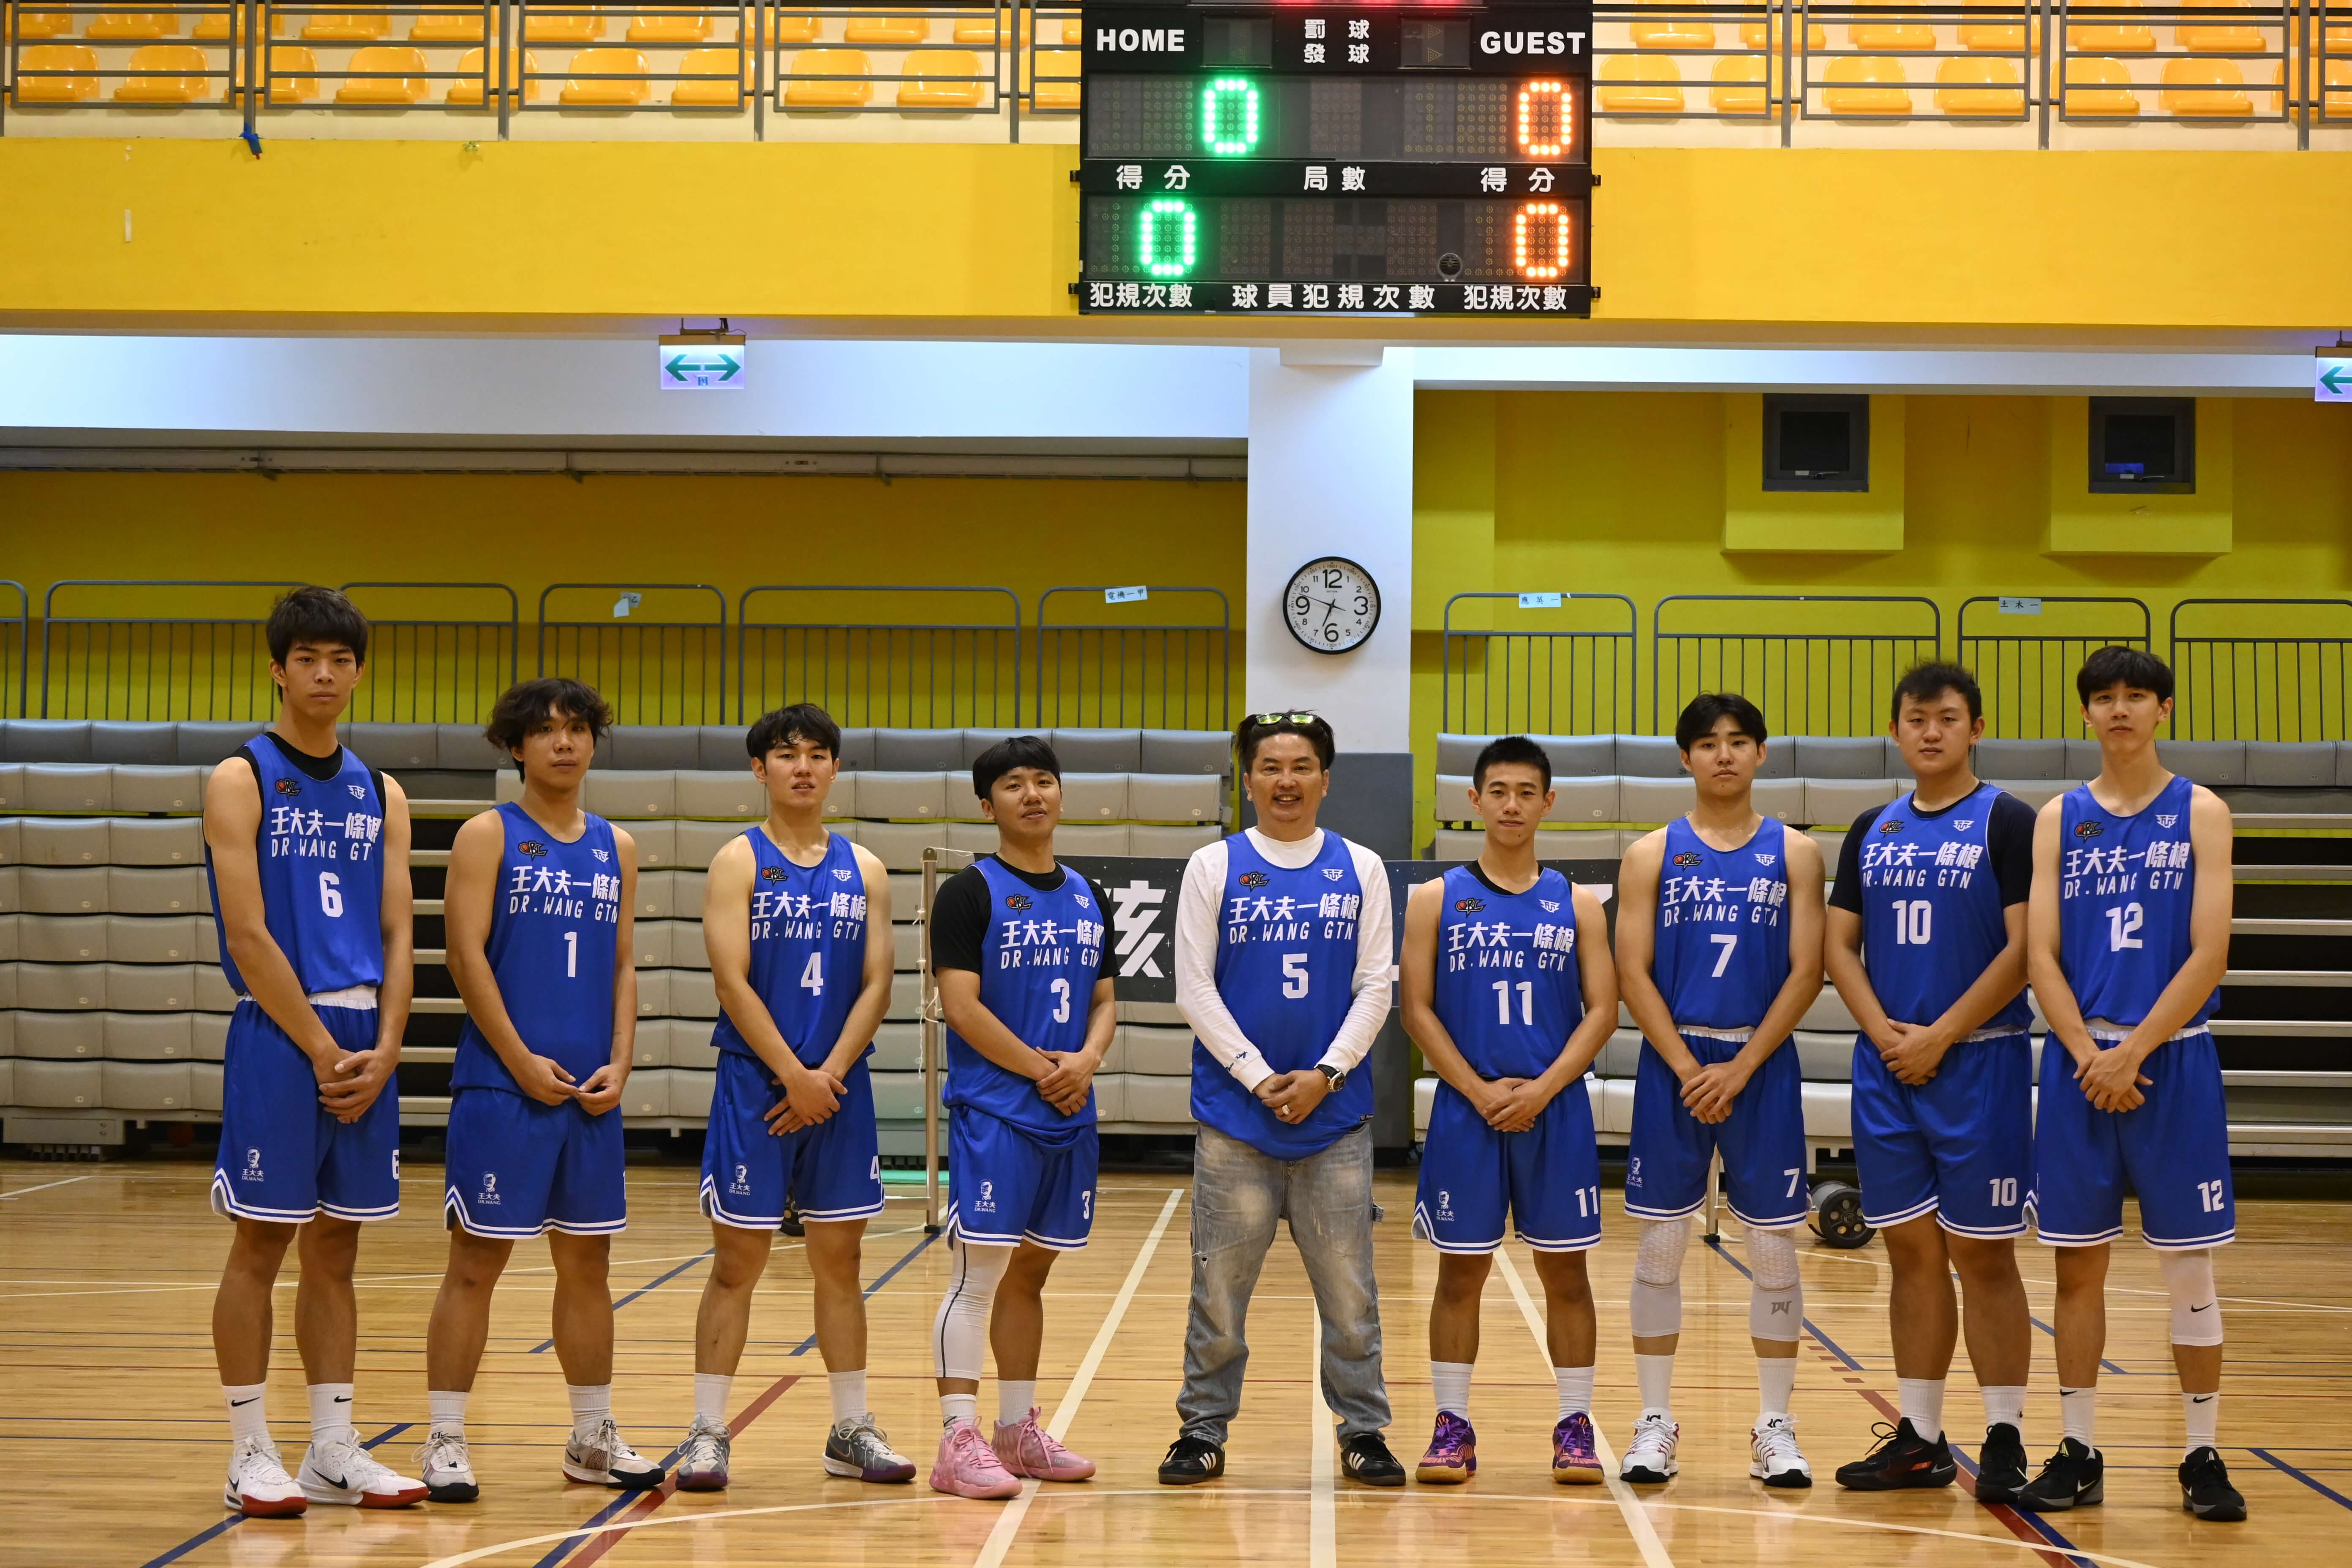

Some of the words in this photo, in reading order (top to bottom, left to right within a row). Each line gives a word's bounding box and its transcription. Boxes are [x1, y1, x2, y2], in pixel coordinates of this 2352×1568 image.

[1097, 29, 1185, 52] HOME
[1304, 19, 1369, 40] 罰球
[1480, 31, 1585, 55] GUEST
[1303, 44, 1369, 64] 發球
[1202, 78, 1259, 154] 0
[1519, 81, 1572, 156] 0
[1116, 166, 1190, 191] 得分
[1303, 166, 1366, 191] 局數
[1481, 168, 1555, 193] 得分
[1141, 201, 1196, 275] 0
[1516, 204, 1569, 278] 0
[1090, 284, 1192, 309] 犯規次數
[1233, 284, 1436, 310] 球員犯規次數
[1464, 285, 1567, 311] 犯規次數
[1322, 569, 1342, 588] 12
[1296, 596, 1310, 615] 9
[1354, 596, 1368, 615] 3
[2001, 600, 2038, 609] 土木一
[1324, 623, 1339, 642] 6
[350, 842, 373, 861] GT
[1862, 841, 1983, 870] 王大夫一條根
[2064, 841, 2190, 878] 王大夫一條根
[319, 871, 343, 917] 6
[752, 891, 866, 921] 王大夫一條根
[1663, 876, 1787, 908] 王大夫一條根
[1228, 893, 1360, 924] 王大夫一條根
[1892, 900, 1932, 945] 10
[1448, 922, 1574, 953] 王大夫一條根
[2106, 902, 2143, 952] 12
[564, 931, 577, 977] 1
[1710, 934, 1737, 977] 7
[800, 952, 824, 996] 4
[1283, 953, 1308, 999] 5
[1051, 978, 1070, 1023] 3
[1492, 980, 1533, 1026] 11
[242, 1169, 264, 1177] 王大夫
[870, 1155, 881, 1184] 4
[1784, 1168, 1800, 1198] 7
[478, 1192, 501, 1200] 王大夫
[730, 1182, 750, 1192] 王大夫
[1575, 1186, 1598, 1217] 11
[1990, 1178, 2017, 1207] 10
[2197, 1179, 2224, 1213] 12
[1082, 1190, 1091, 1220] 3
